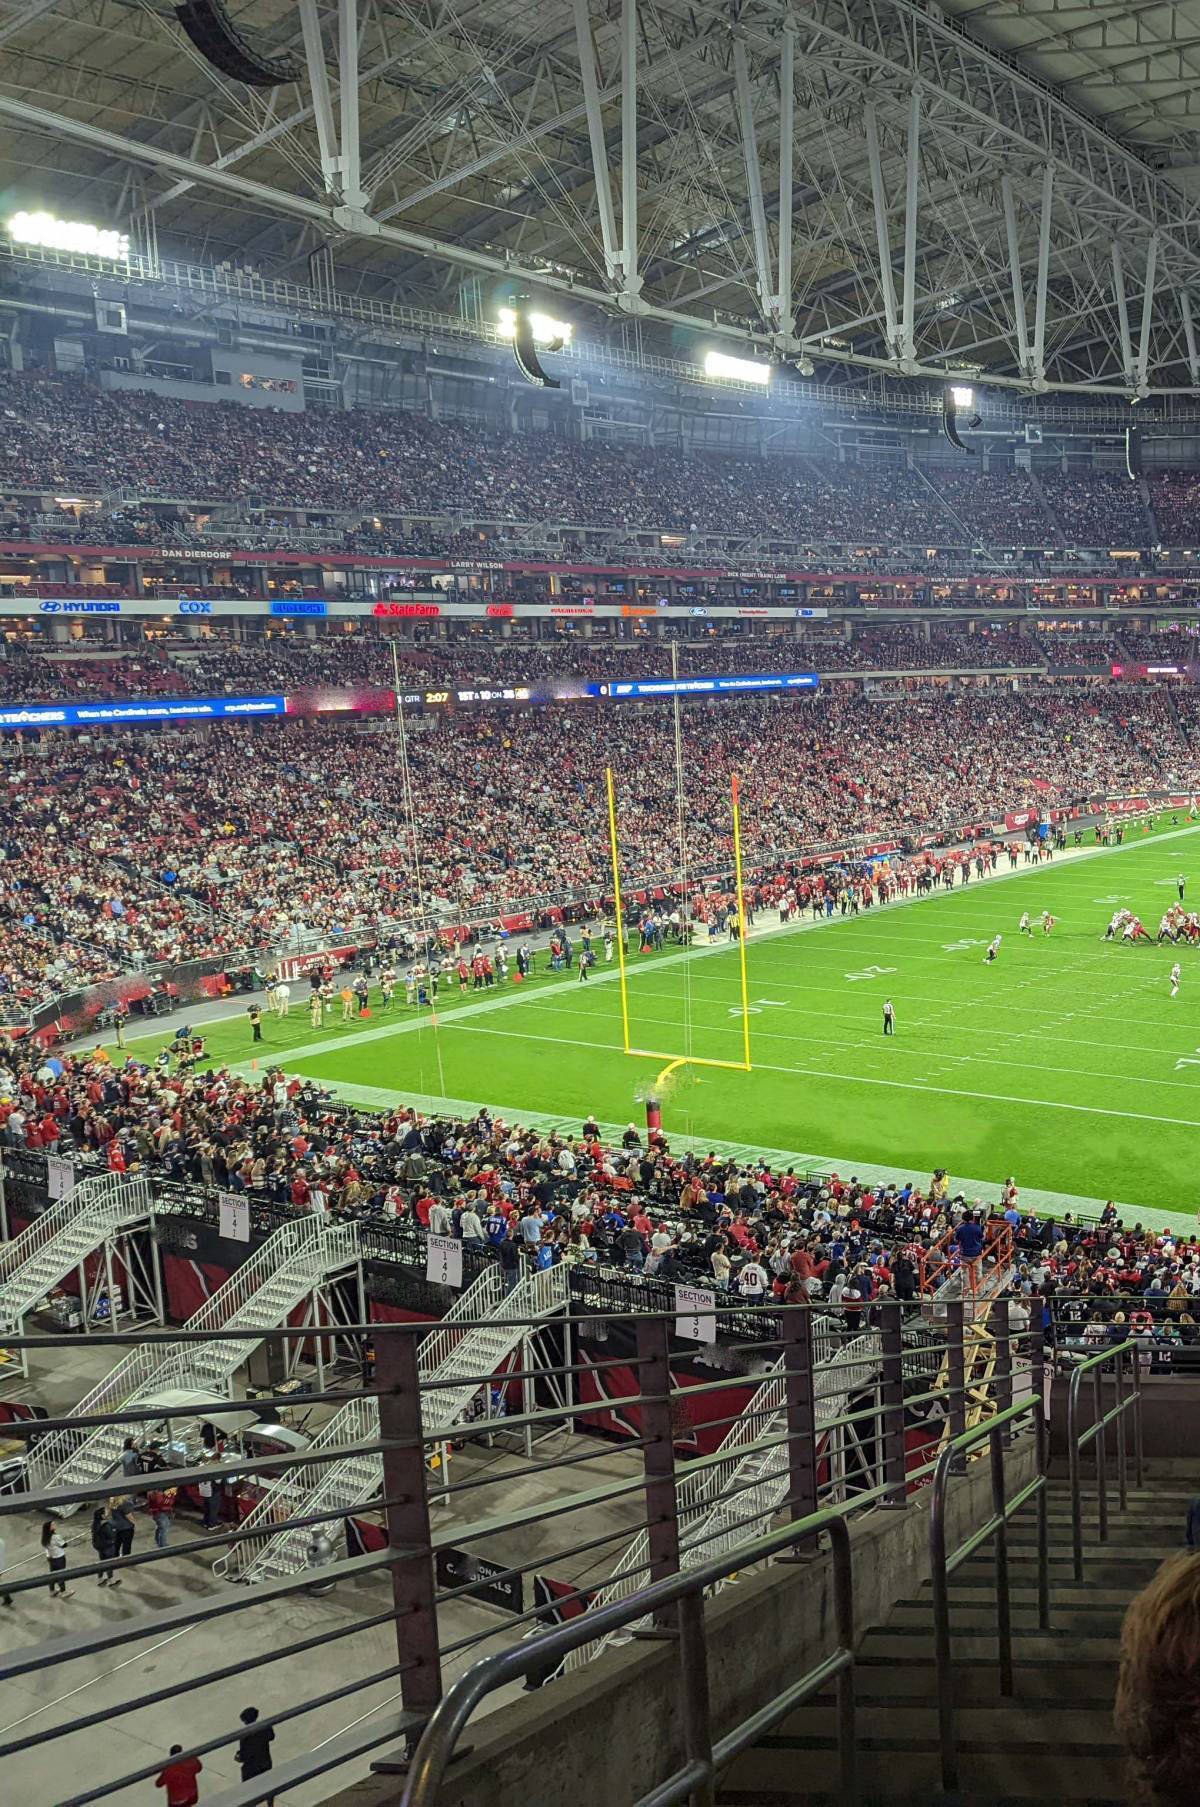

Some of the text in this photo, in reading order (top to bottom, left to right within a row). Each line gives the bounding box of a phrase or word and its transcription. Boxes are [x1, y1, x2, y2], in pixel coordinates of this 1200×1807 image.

[162, 550, 183, 558] DAN
[184, 551, 233, 559] DIERDORF
[451, 560, 504, 569] LARRY WILSON
[63, 602, 121, 612] HYUNDAI
[179, 601, 213, 613] COX
[404, 694, 421, 703] QTR
[426, 692, 449, 703] 2:07
[50, 1160, 72, 1171] SECTION
[221, 1196, 246, 1208] SECTION
[430, 1237, 460, 1251] SECTION
[744, 1272, 758, 1286] 40
[678, 1289, 712, 1304] SECTION
